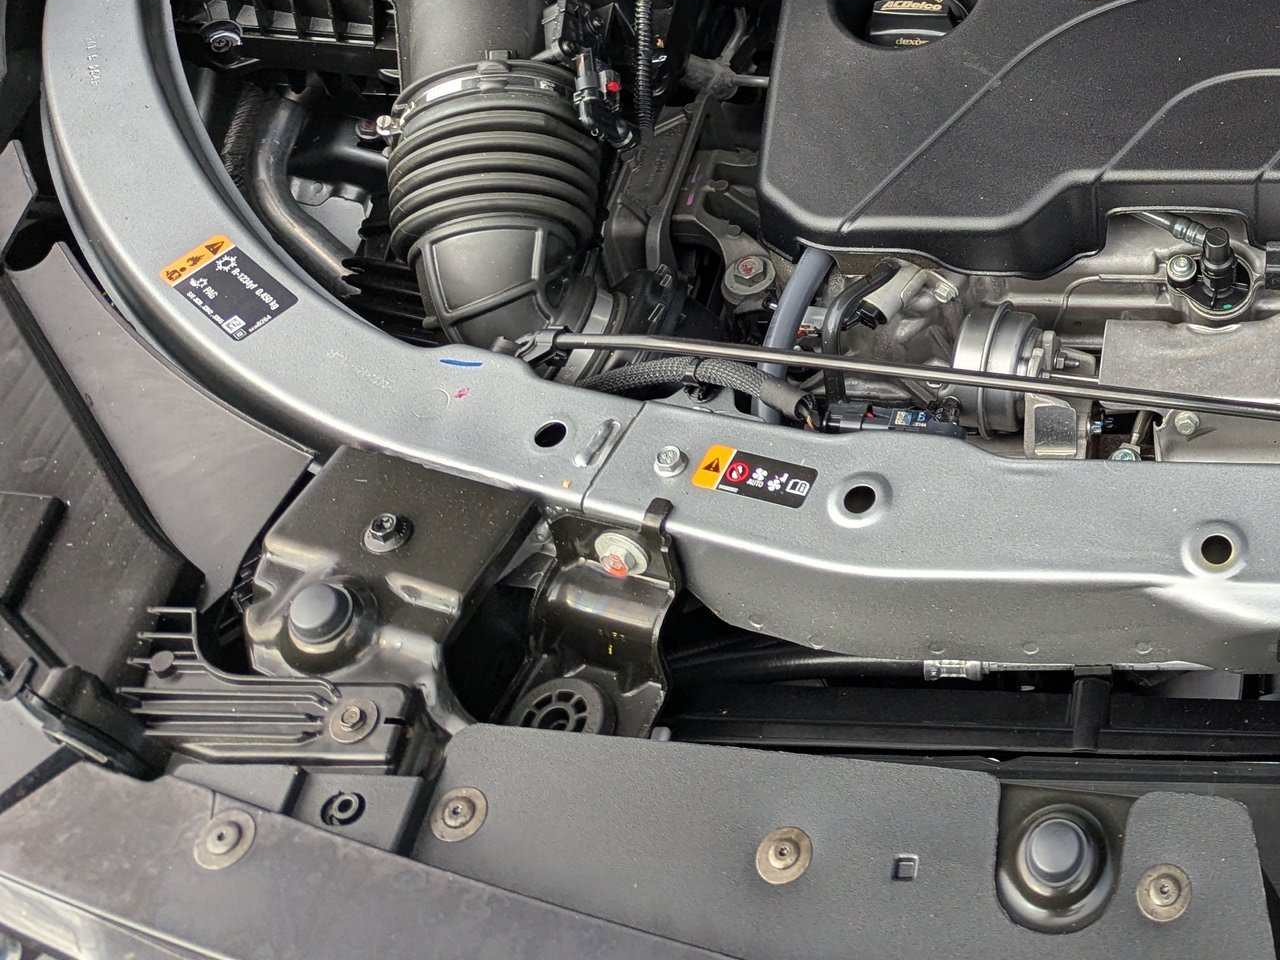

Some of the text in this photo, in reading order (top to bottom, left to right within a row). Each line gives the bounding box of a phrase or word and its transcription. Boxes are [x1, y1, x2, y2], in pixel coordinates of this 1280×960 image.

[880, 0, 942, 11] ACDelco
[203, 286, 218, 299] PAG
[231, 267, 258, 290] R-1234yf
[268, 300, 279, 310] kg
[746, 478, 764, 488] AUTO
